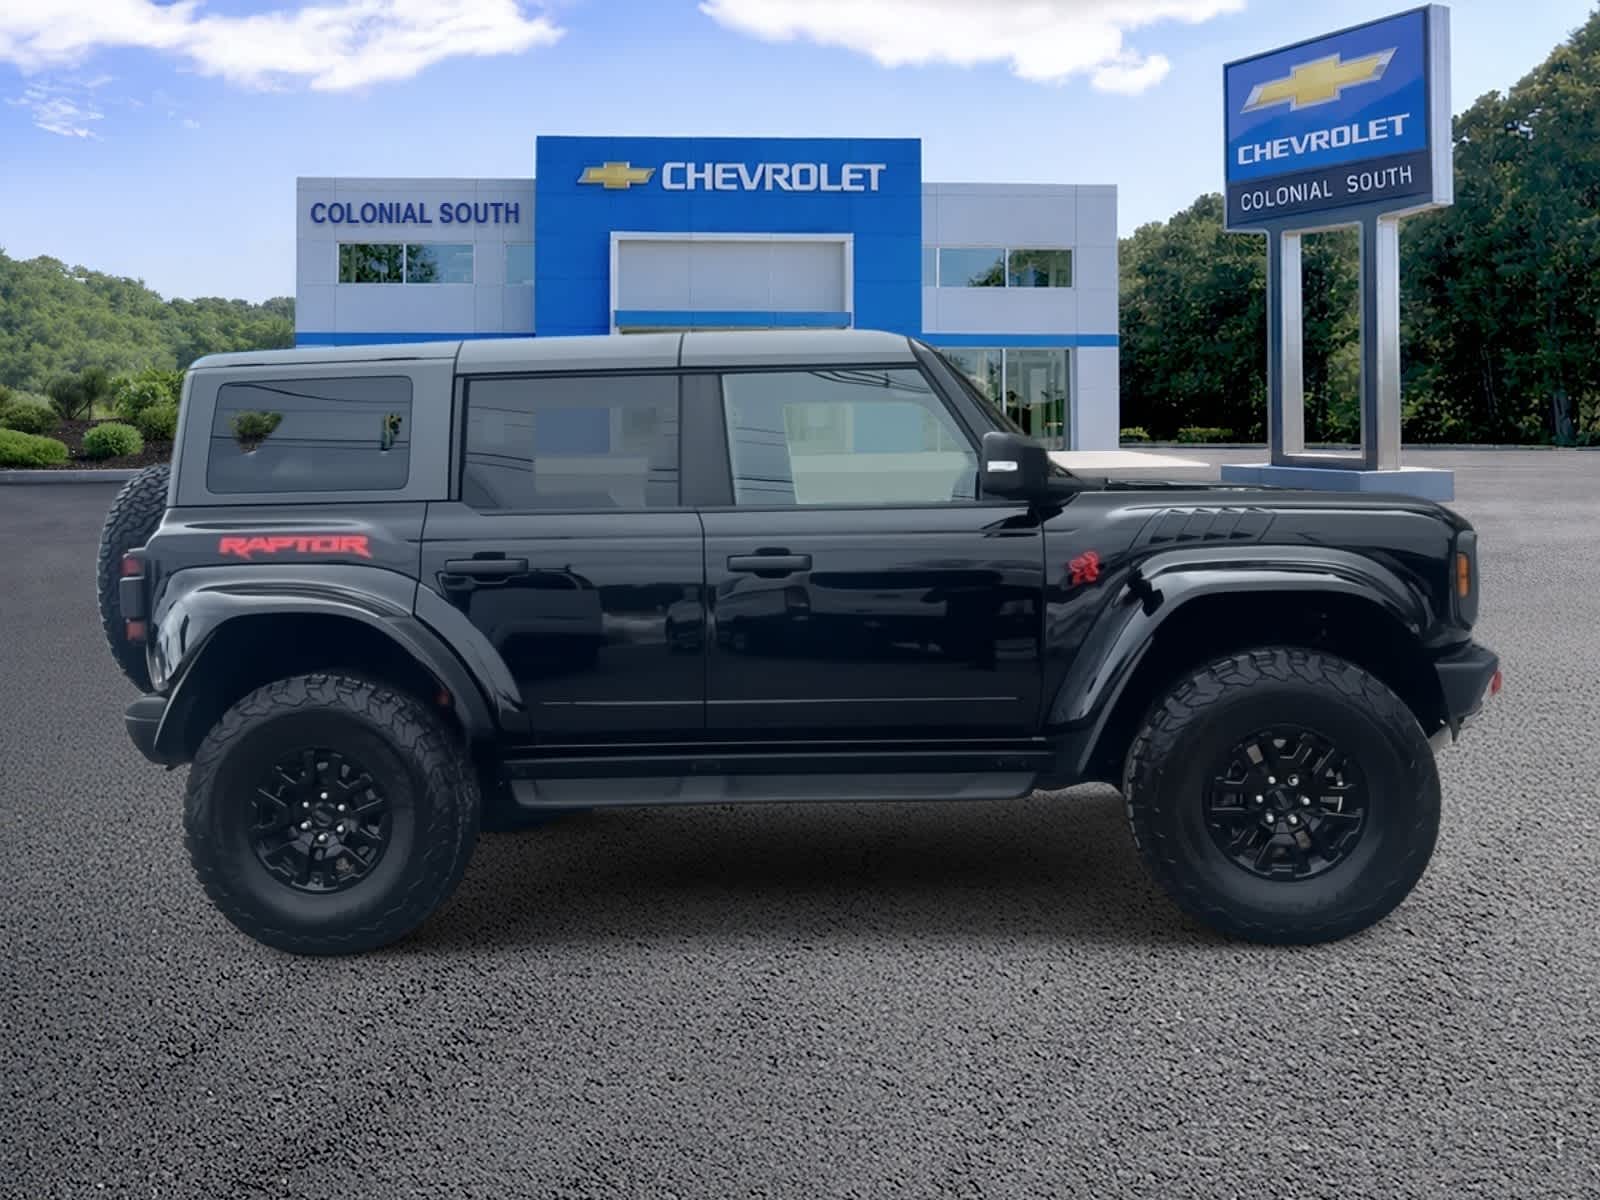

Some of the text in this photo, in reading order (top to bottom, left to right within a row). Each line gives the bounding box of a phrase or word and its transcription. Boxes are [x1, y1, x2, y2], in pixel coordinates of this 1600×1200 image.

[1238, 113, 1410, 165] CHEVROLET
[662, 162, 887, 192] CHEVROLET
[1241, 165, 1412, 211] COLONIAL SOUTH
[311, 202, 520, 225] COLONIAL SOUTH
[219, 535, 373, 560] RAPTOR
